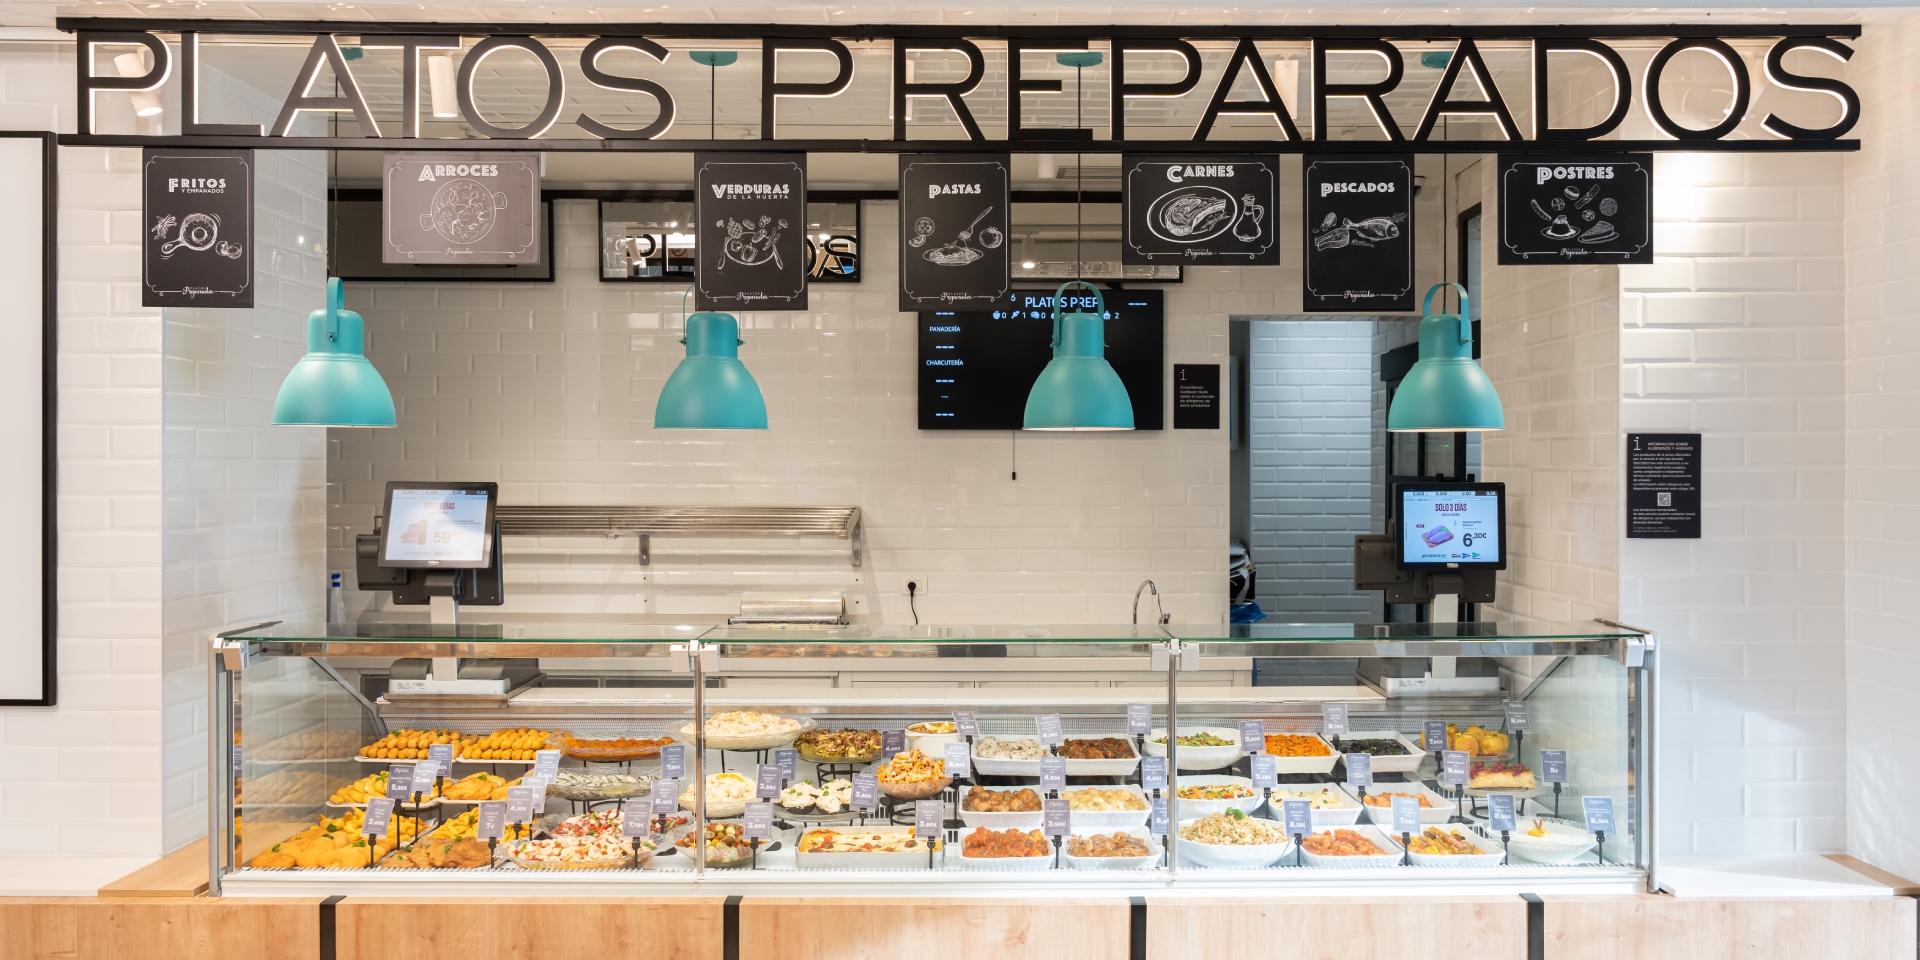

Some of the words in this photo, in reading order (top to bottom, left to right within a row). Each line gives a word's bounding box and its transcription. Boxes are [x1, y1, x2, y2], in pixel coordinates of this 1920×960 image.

[77, 31, 677, 139] PLATOS
[761, 37, 1861, 141] PREPARADOS
[418, 164, 499, 182] ARROCES
[1166, 165, 1235, 183] CARNES
[1536, 166, 1615, 185] POSTRES
[168, 178, 227, 193] FRITOS
[711, 183, 790, 199] VERDURAS
[928, 183, 982, 199] PASTAS
[1320, 182, 1396, 198] PESCADOS
[929, 325, 961, 333] PANADERÍA
[926, 358, 964, 366] CHARCUTERÍA
[443, 500, 455, 510] DÍAS
[1454, 502, 1467, 511] DÍAS
